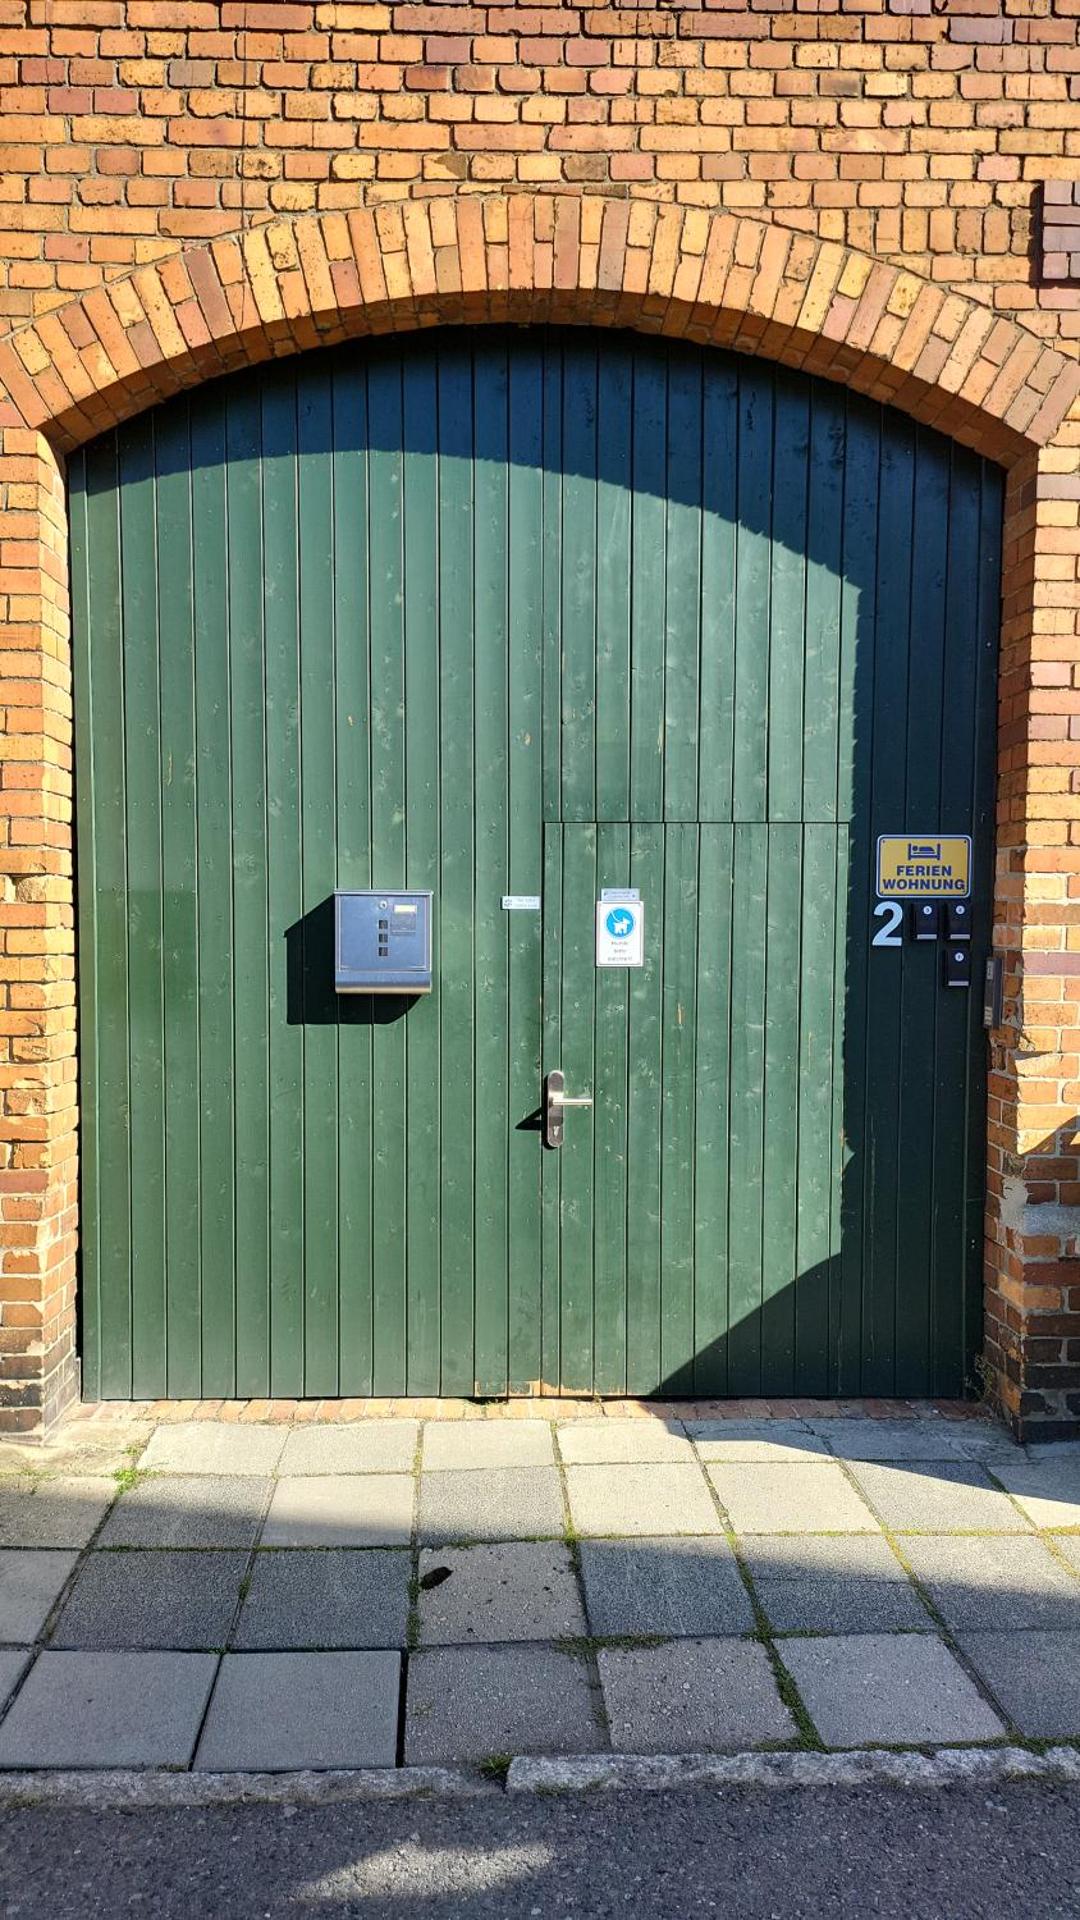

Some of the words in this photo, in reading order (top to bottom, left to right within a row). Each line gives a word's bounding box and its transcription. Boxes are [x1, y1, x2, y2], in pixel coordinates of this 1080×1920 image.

[896, 865, 952, 876] FERIEN
[882, 879, 965, 890] WOHNUNG
[872, 901, 903, 946] 2
